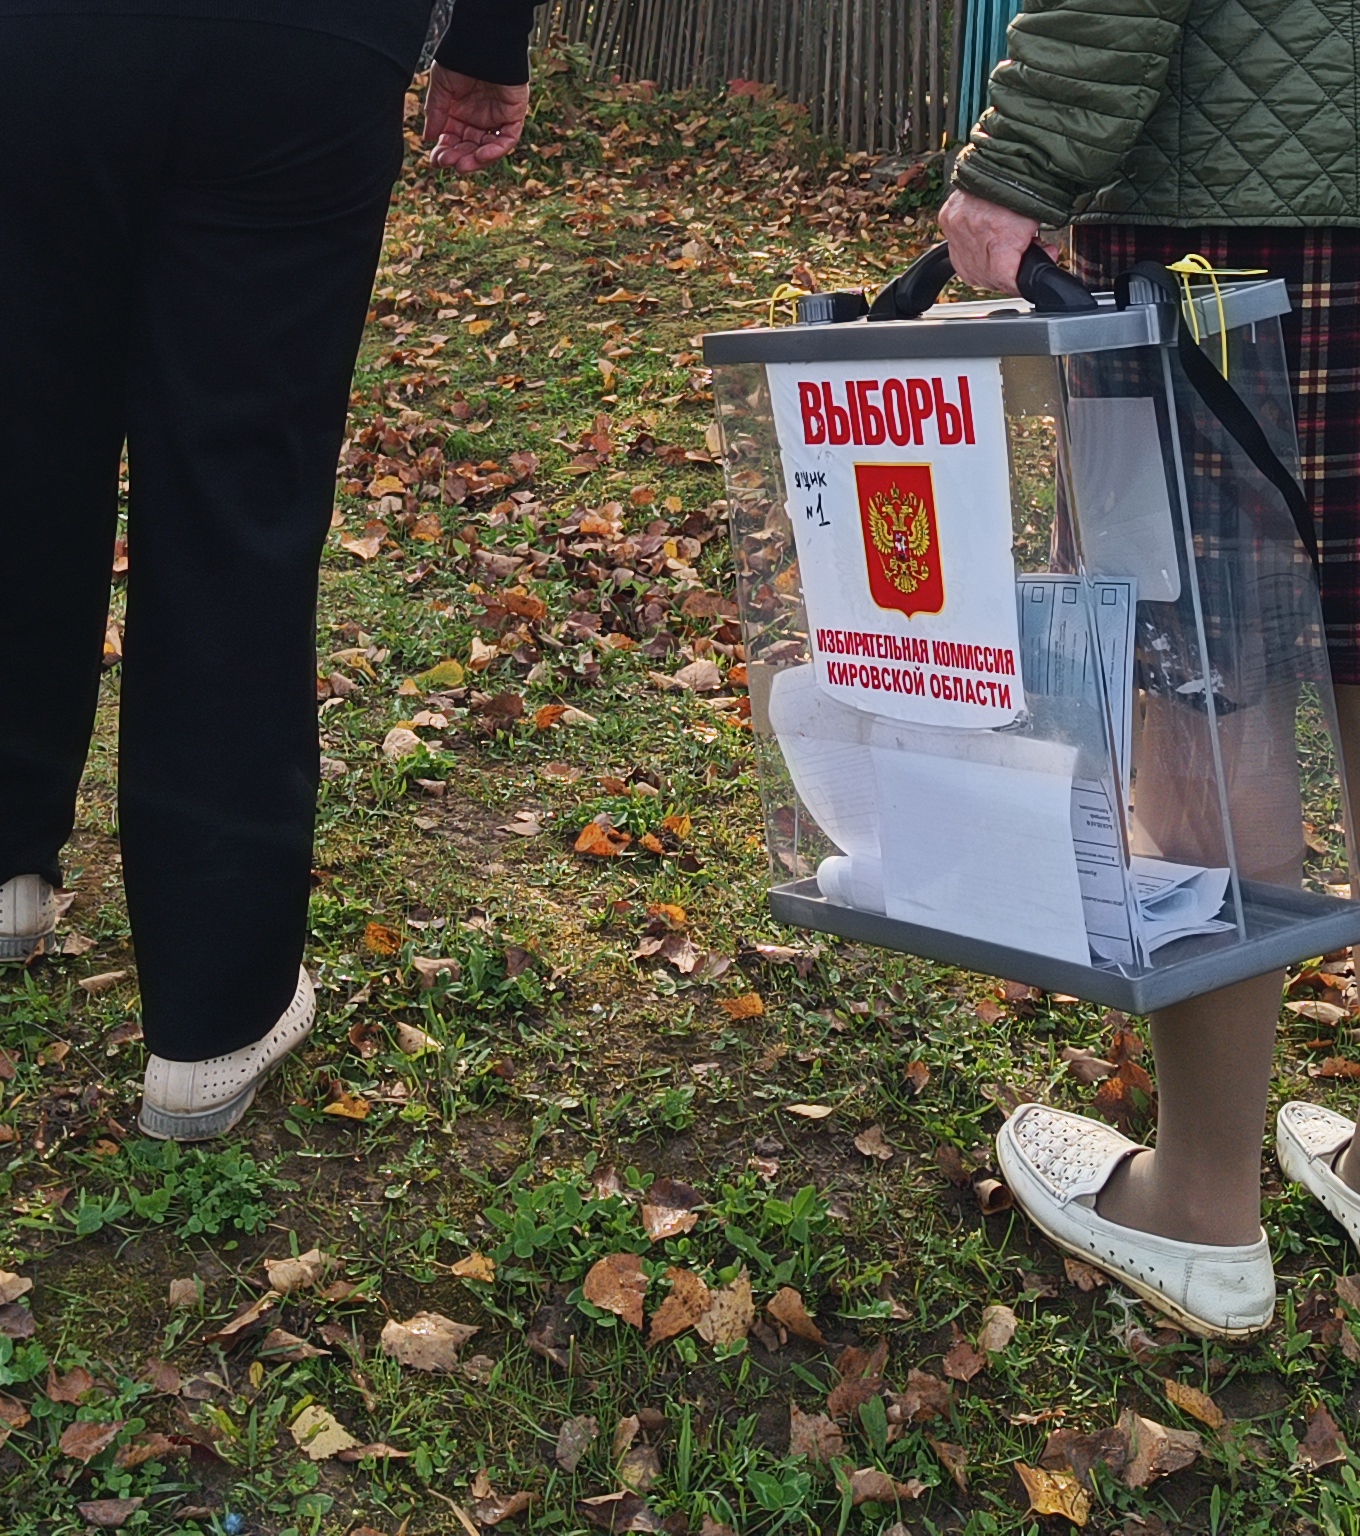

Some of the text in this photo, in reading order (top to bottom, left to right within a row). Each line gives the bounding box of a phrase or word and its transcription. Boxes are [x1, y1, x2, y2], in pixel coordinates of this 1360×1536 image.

[797, 375, 976, 446] ВЫБОРЫ
[816, 628, 930, 665] ИЗБИРАТЕЛЬНАЯ
[931, 639, 1016, 676] КОМИССИЯ
[826, 660, 1012, 710] КИРОВСКОЙ ОБЛАСТИ
